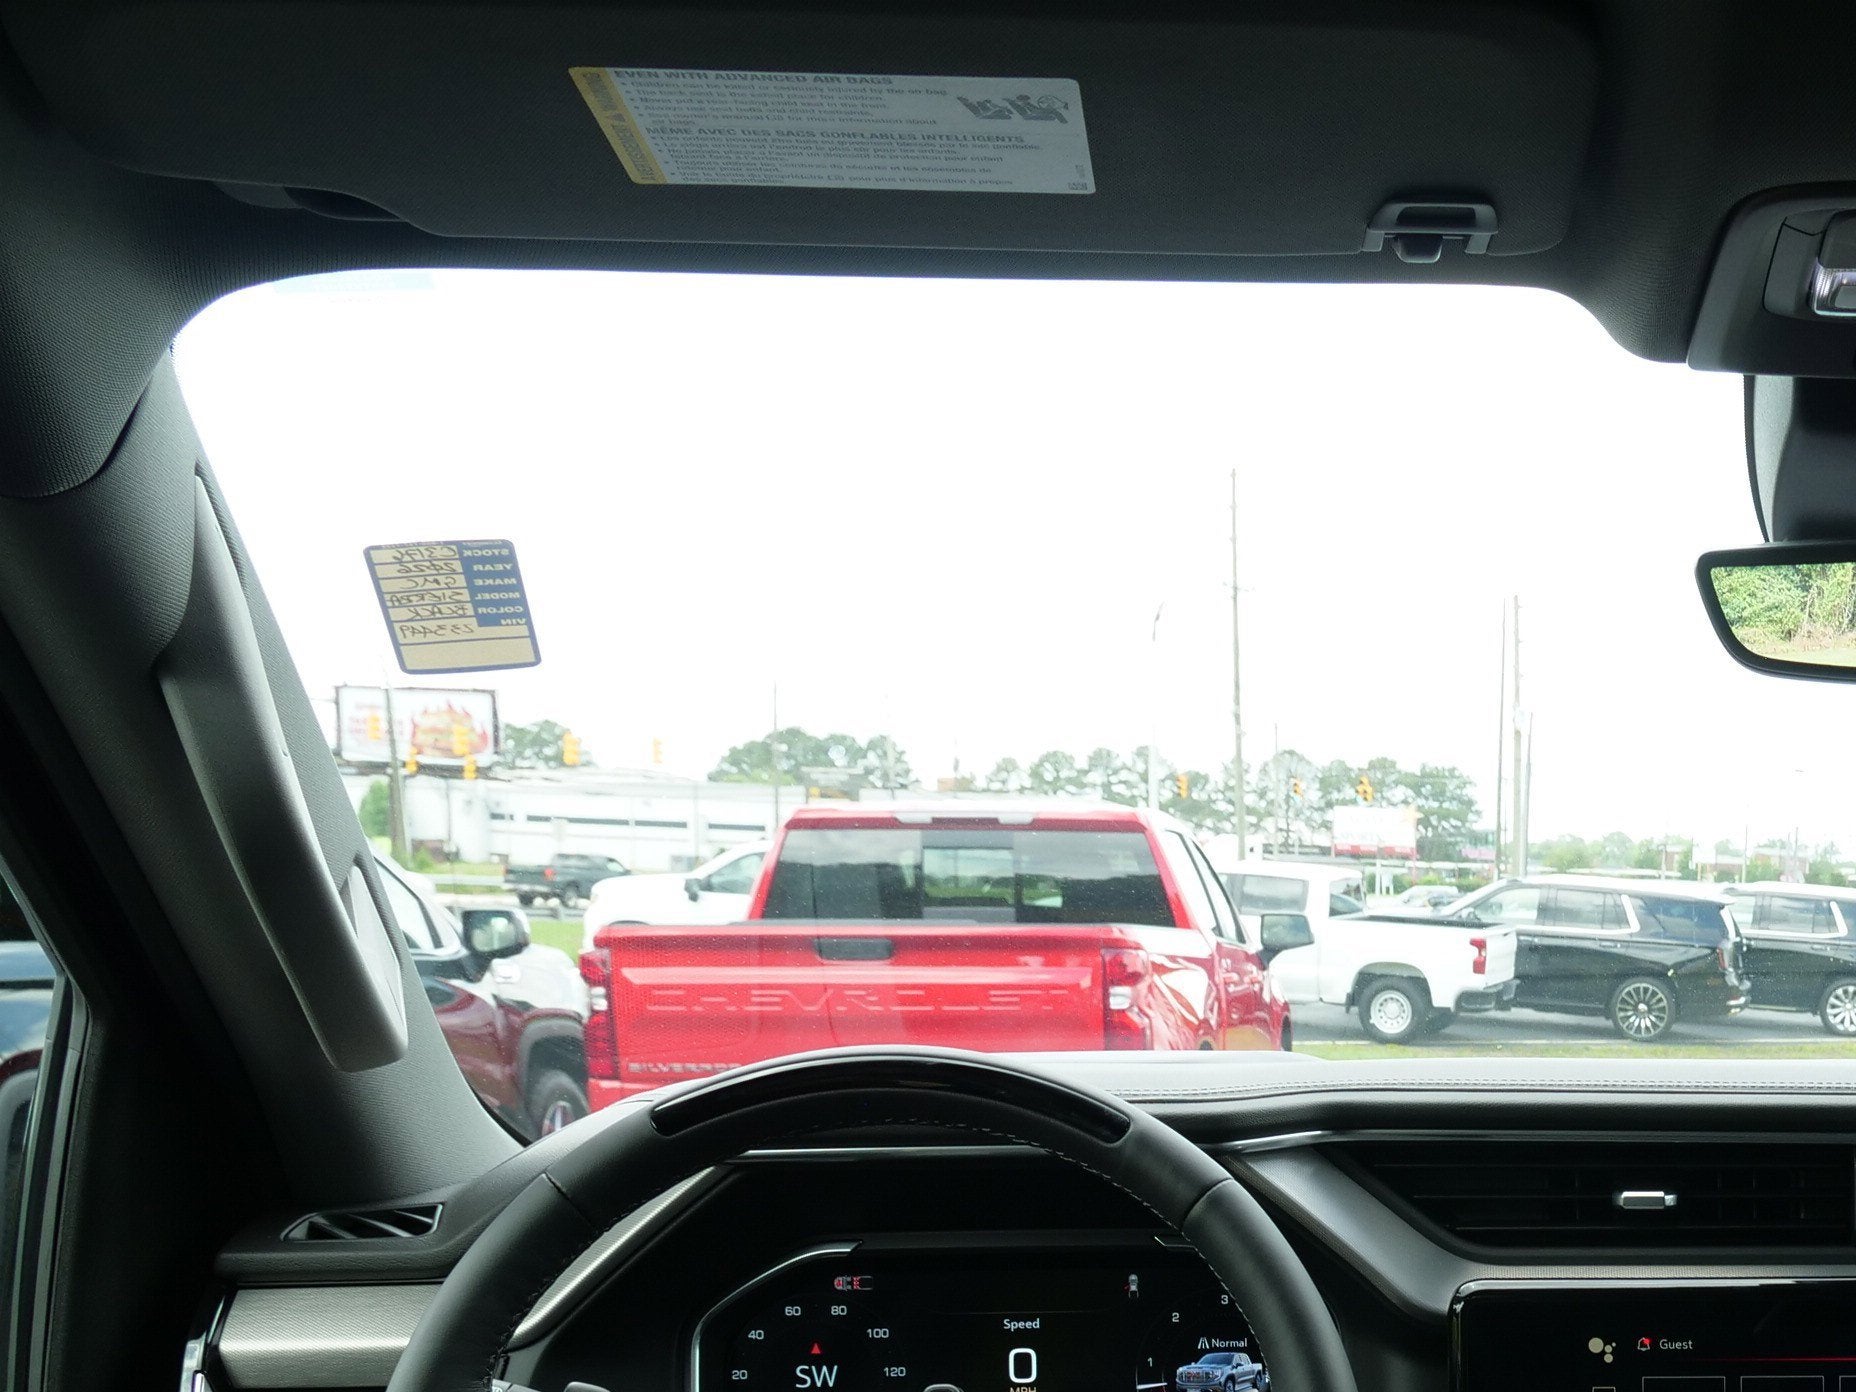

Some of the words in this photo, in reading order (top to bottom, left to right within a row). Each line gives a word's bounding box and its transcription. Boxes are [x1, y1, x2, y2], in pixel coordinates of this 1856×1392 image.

[615, 70, 659, 79] EVEN
[665, 72, 708, 80] WITH
[715, 73, 807, 83] ADVANCED
[813, 75, 842, 83] AIR
[849, 76, 893, 85] BAGS
[646, 988, 1069, 1012] CHEVROLET
[1221, 1294, 1229, 1306] 3
[785, 1305, 802, 1317] 60
[831, 1305, 848, 1316] 80
[1172, 1311, 1180, 1323] 2
[1003, 1318, 1041, 1332] Speed
[748, 1329, 765, 1341] 40
[866, 1328, 891, 1340] 100
[1211, 1337, 1248, 1349] Normal
[1659, 1338, 1693, 1351] Guest
[1008, 1347, 1038, 1385] 0
[1147, 1356, 1154, 1368] 1
[731, 1369, 749, 1381] 20
[795, 1363, 839, 1390] SW
[883, 1366, 907, 1379] 120
